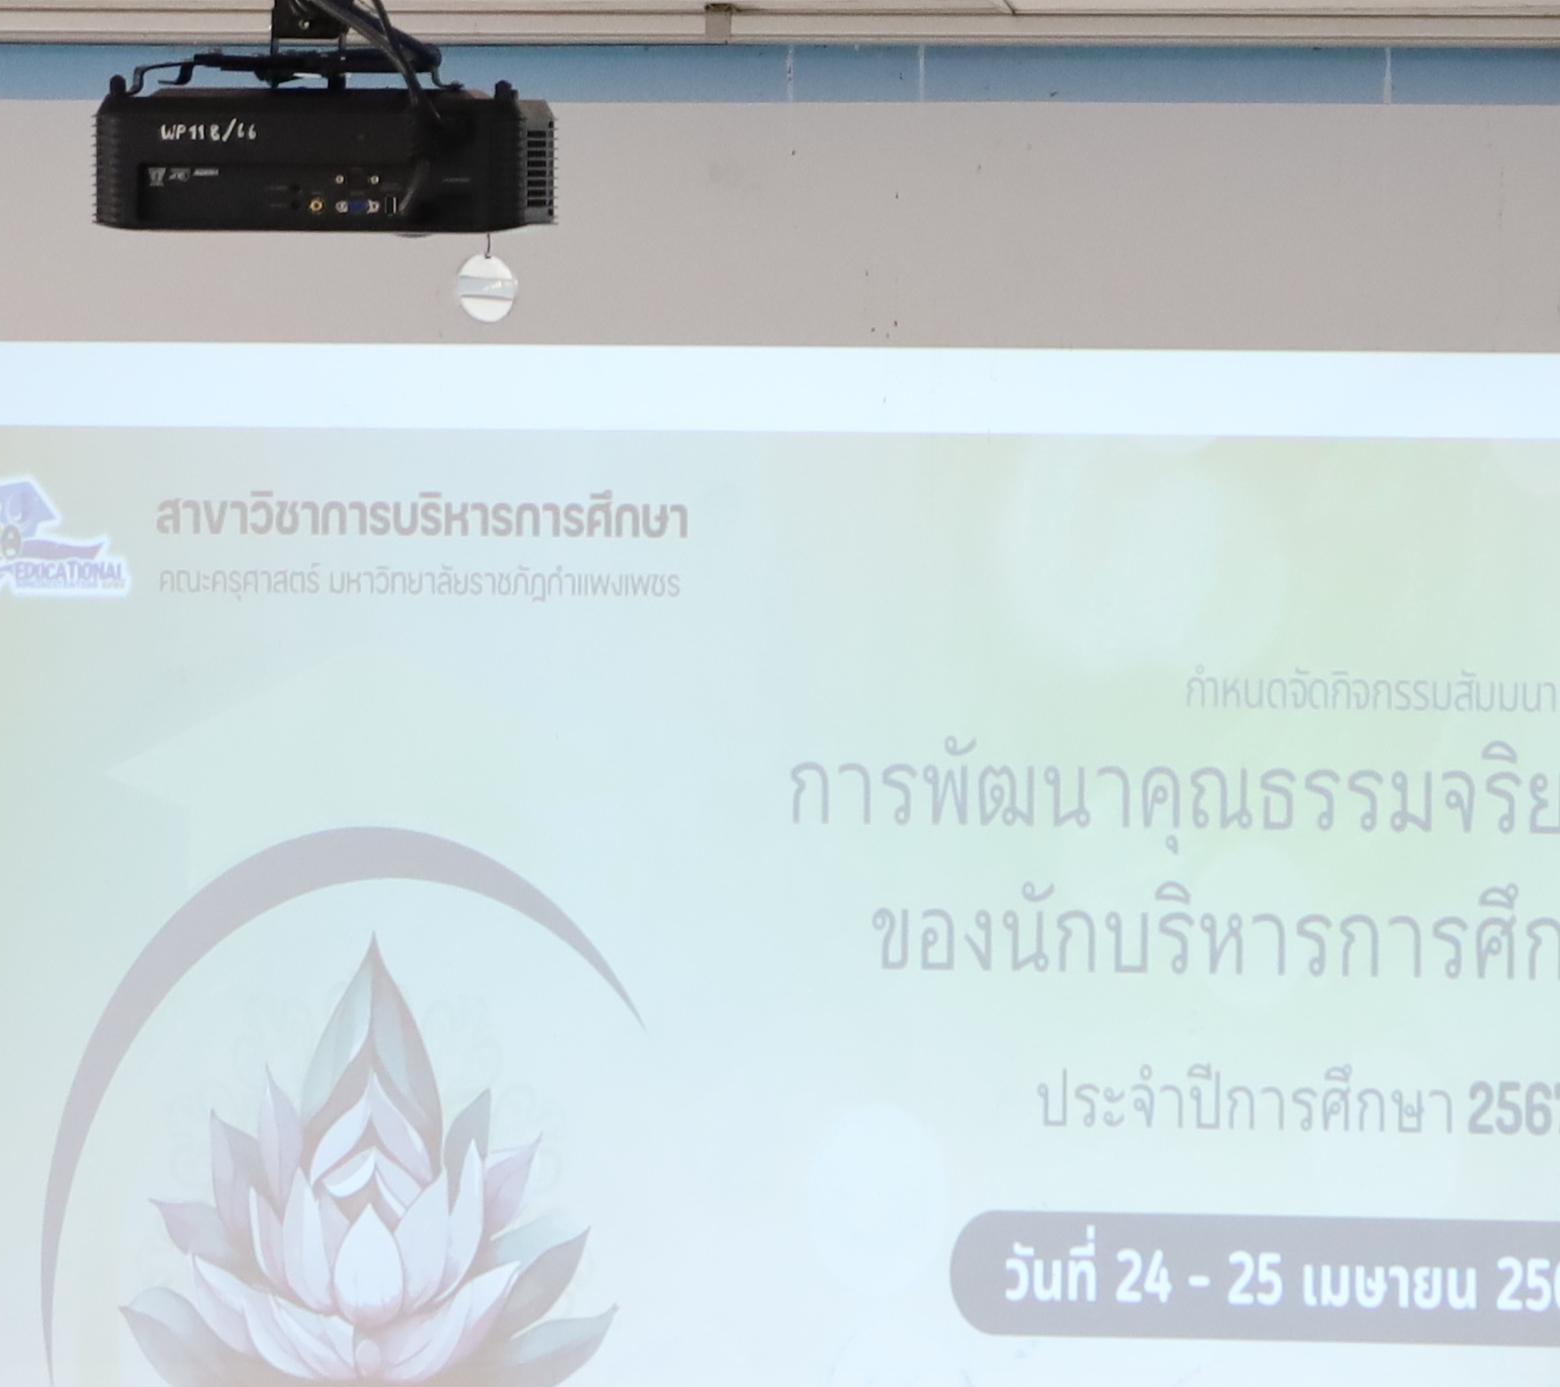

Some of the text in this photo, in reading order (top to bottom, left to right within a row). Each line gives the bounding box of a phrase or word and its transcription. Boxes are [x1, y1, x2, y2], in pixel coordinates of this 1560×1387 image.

[156, 488, 689, 539] สาขาวิชาการบริหารการศึกษา
[159, 561, 681, 603] คณะครุศาสตร์ มหาวิทยาลัยราชภัฏกำแพงเพชร
[1036, 1062, 1454, 1135] ประจำปีการศึกษา
[1005, 1225, 1096, 1302] วันที่
[1115, 1248, 1172, 1303] 24
[1227, 1250, 1284, 1306] 25
[1303, 1263, 1477, 1310] เมษายน
